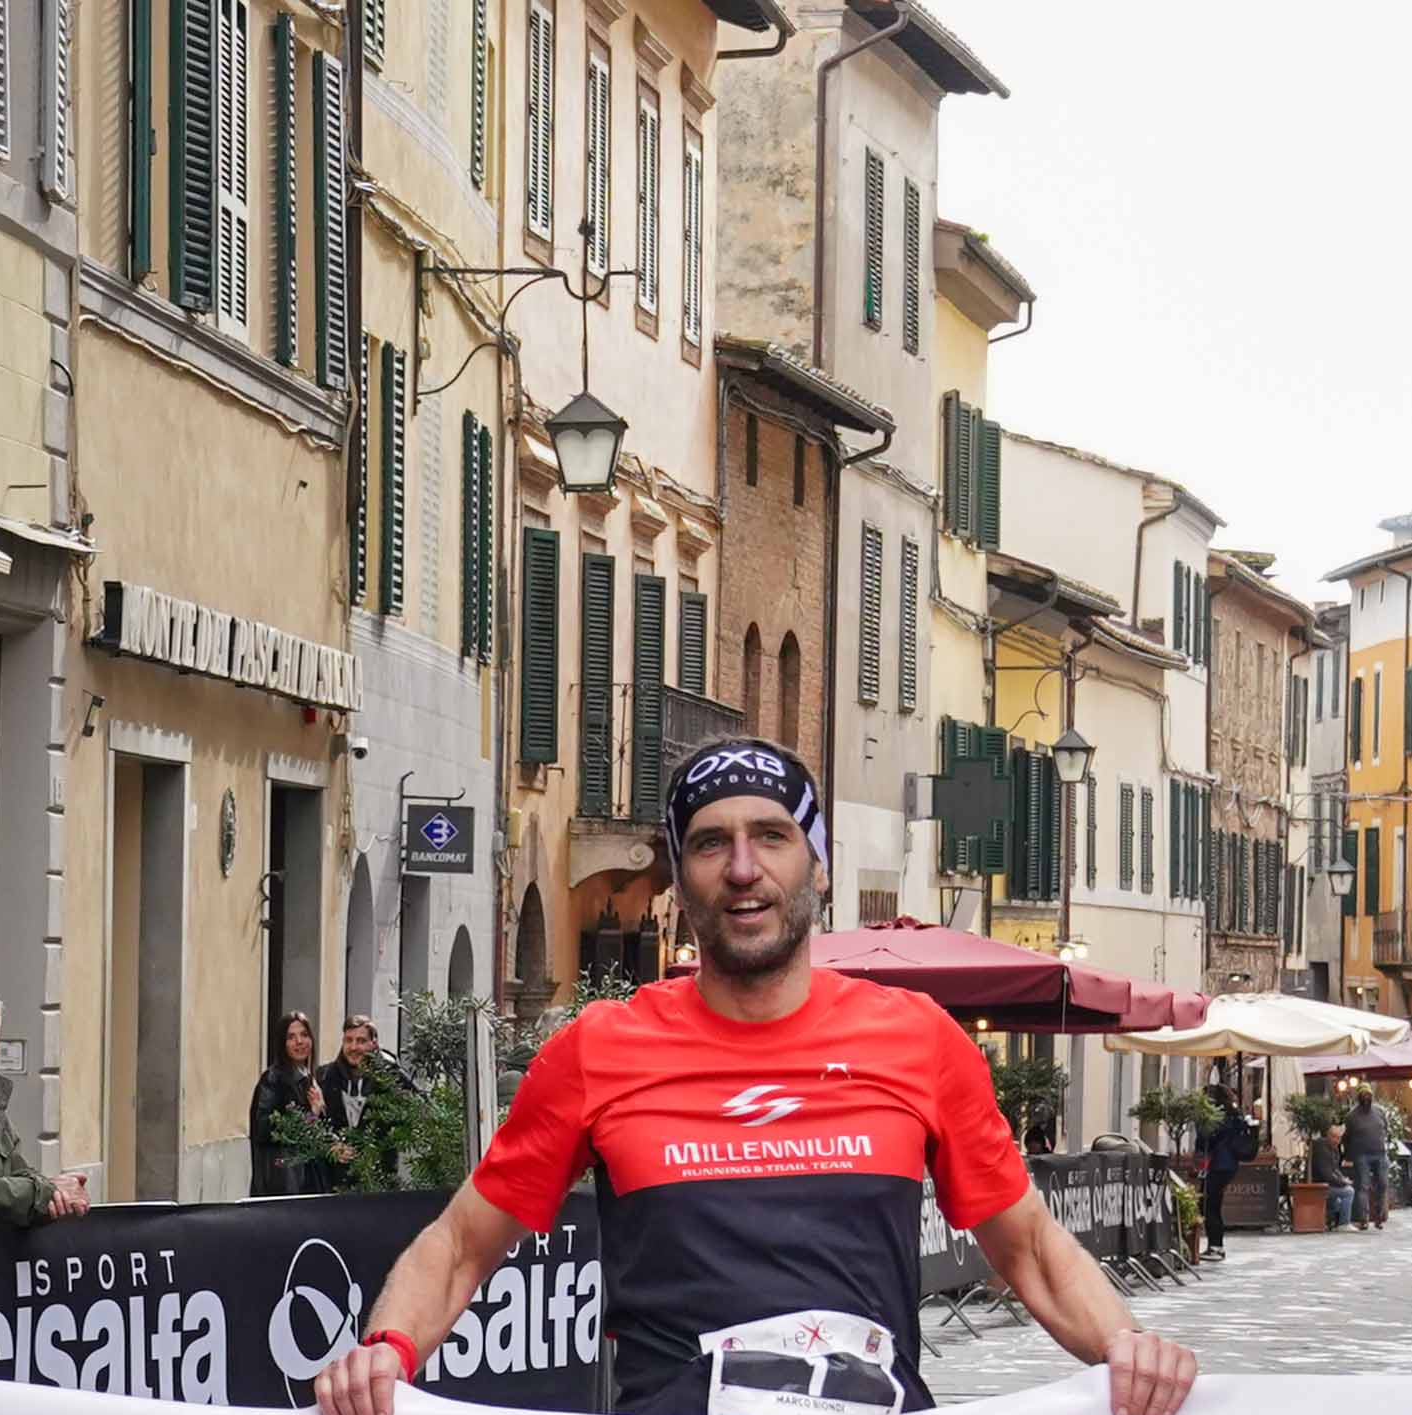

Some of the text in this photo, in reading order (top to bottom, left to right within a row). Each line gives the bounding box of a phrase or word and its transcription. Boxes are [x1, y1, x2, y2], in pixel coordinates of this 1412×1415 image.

[119, 582, 197, 667] MONTE
[687, 750, 786, 784] OXB
[687, 774, 787, 803] OXYBURN
[411, 851, 467, 863] BANCOMAT
[664, 1135, 872, 1166] MILLENNIUM
[682, 1160, 854, 1177] RUNNING & TRAIL TEAM
[35, 1249, 176, 1296] SPORT
[776, 1395, 811, 1409] MARCO
